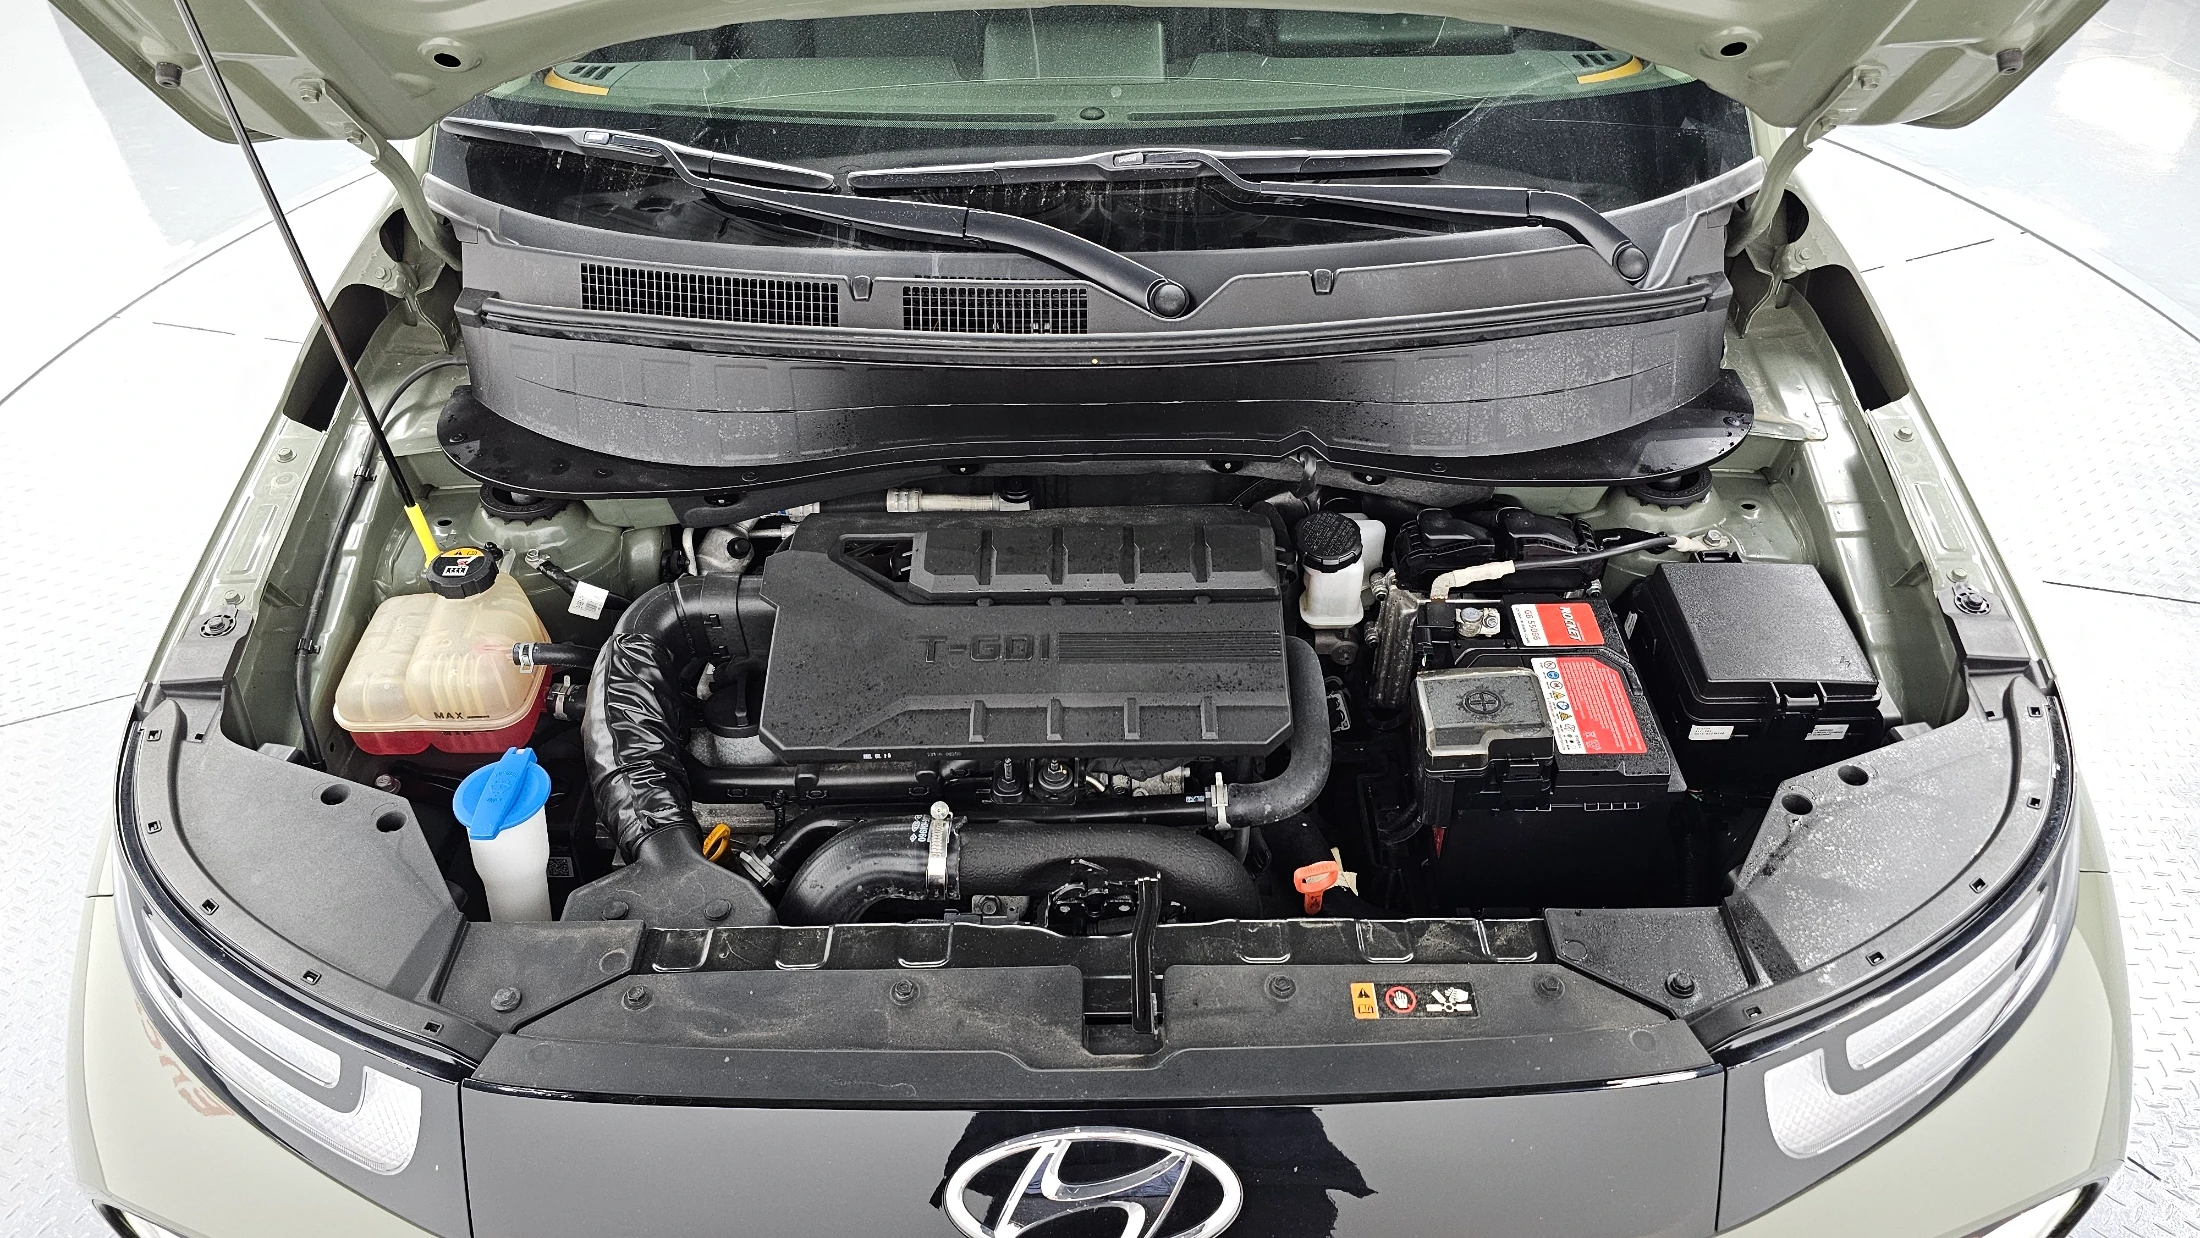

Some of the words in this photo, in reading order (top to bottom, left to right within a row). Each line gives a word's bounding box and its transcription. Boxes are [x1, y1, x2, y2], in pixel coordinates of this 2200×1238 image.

[1560, 606, 1583, 643] ROCKET
[917, 634, 1050, 663] T-GDI
[433, 711, 466, 720] MAX
